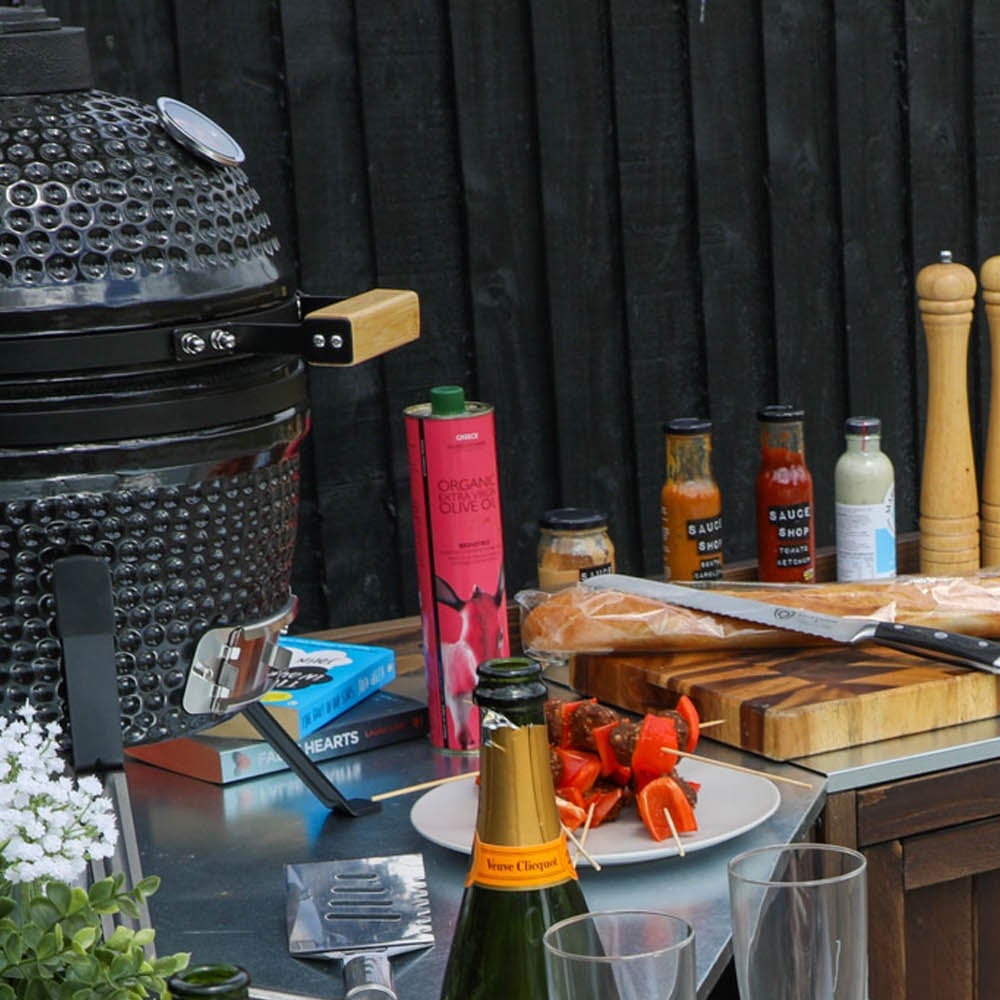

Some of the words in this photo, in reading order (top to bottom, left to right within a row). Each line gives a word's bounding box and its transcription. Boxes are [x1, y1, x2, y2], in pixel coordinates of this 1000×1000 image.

[439, 501, 481, 514] OLIVE
[769, 506, 811, 521] SAUCE
[778, 526, 810, 538] SHOP
[304, 730, 360, 756] HEARTS
[486, 857, 514, 872] Veuve
[516, 856, 559, 873] Clicquot
